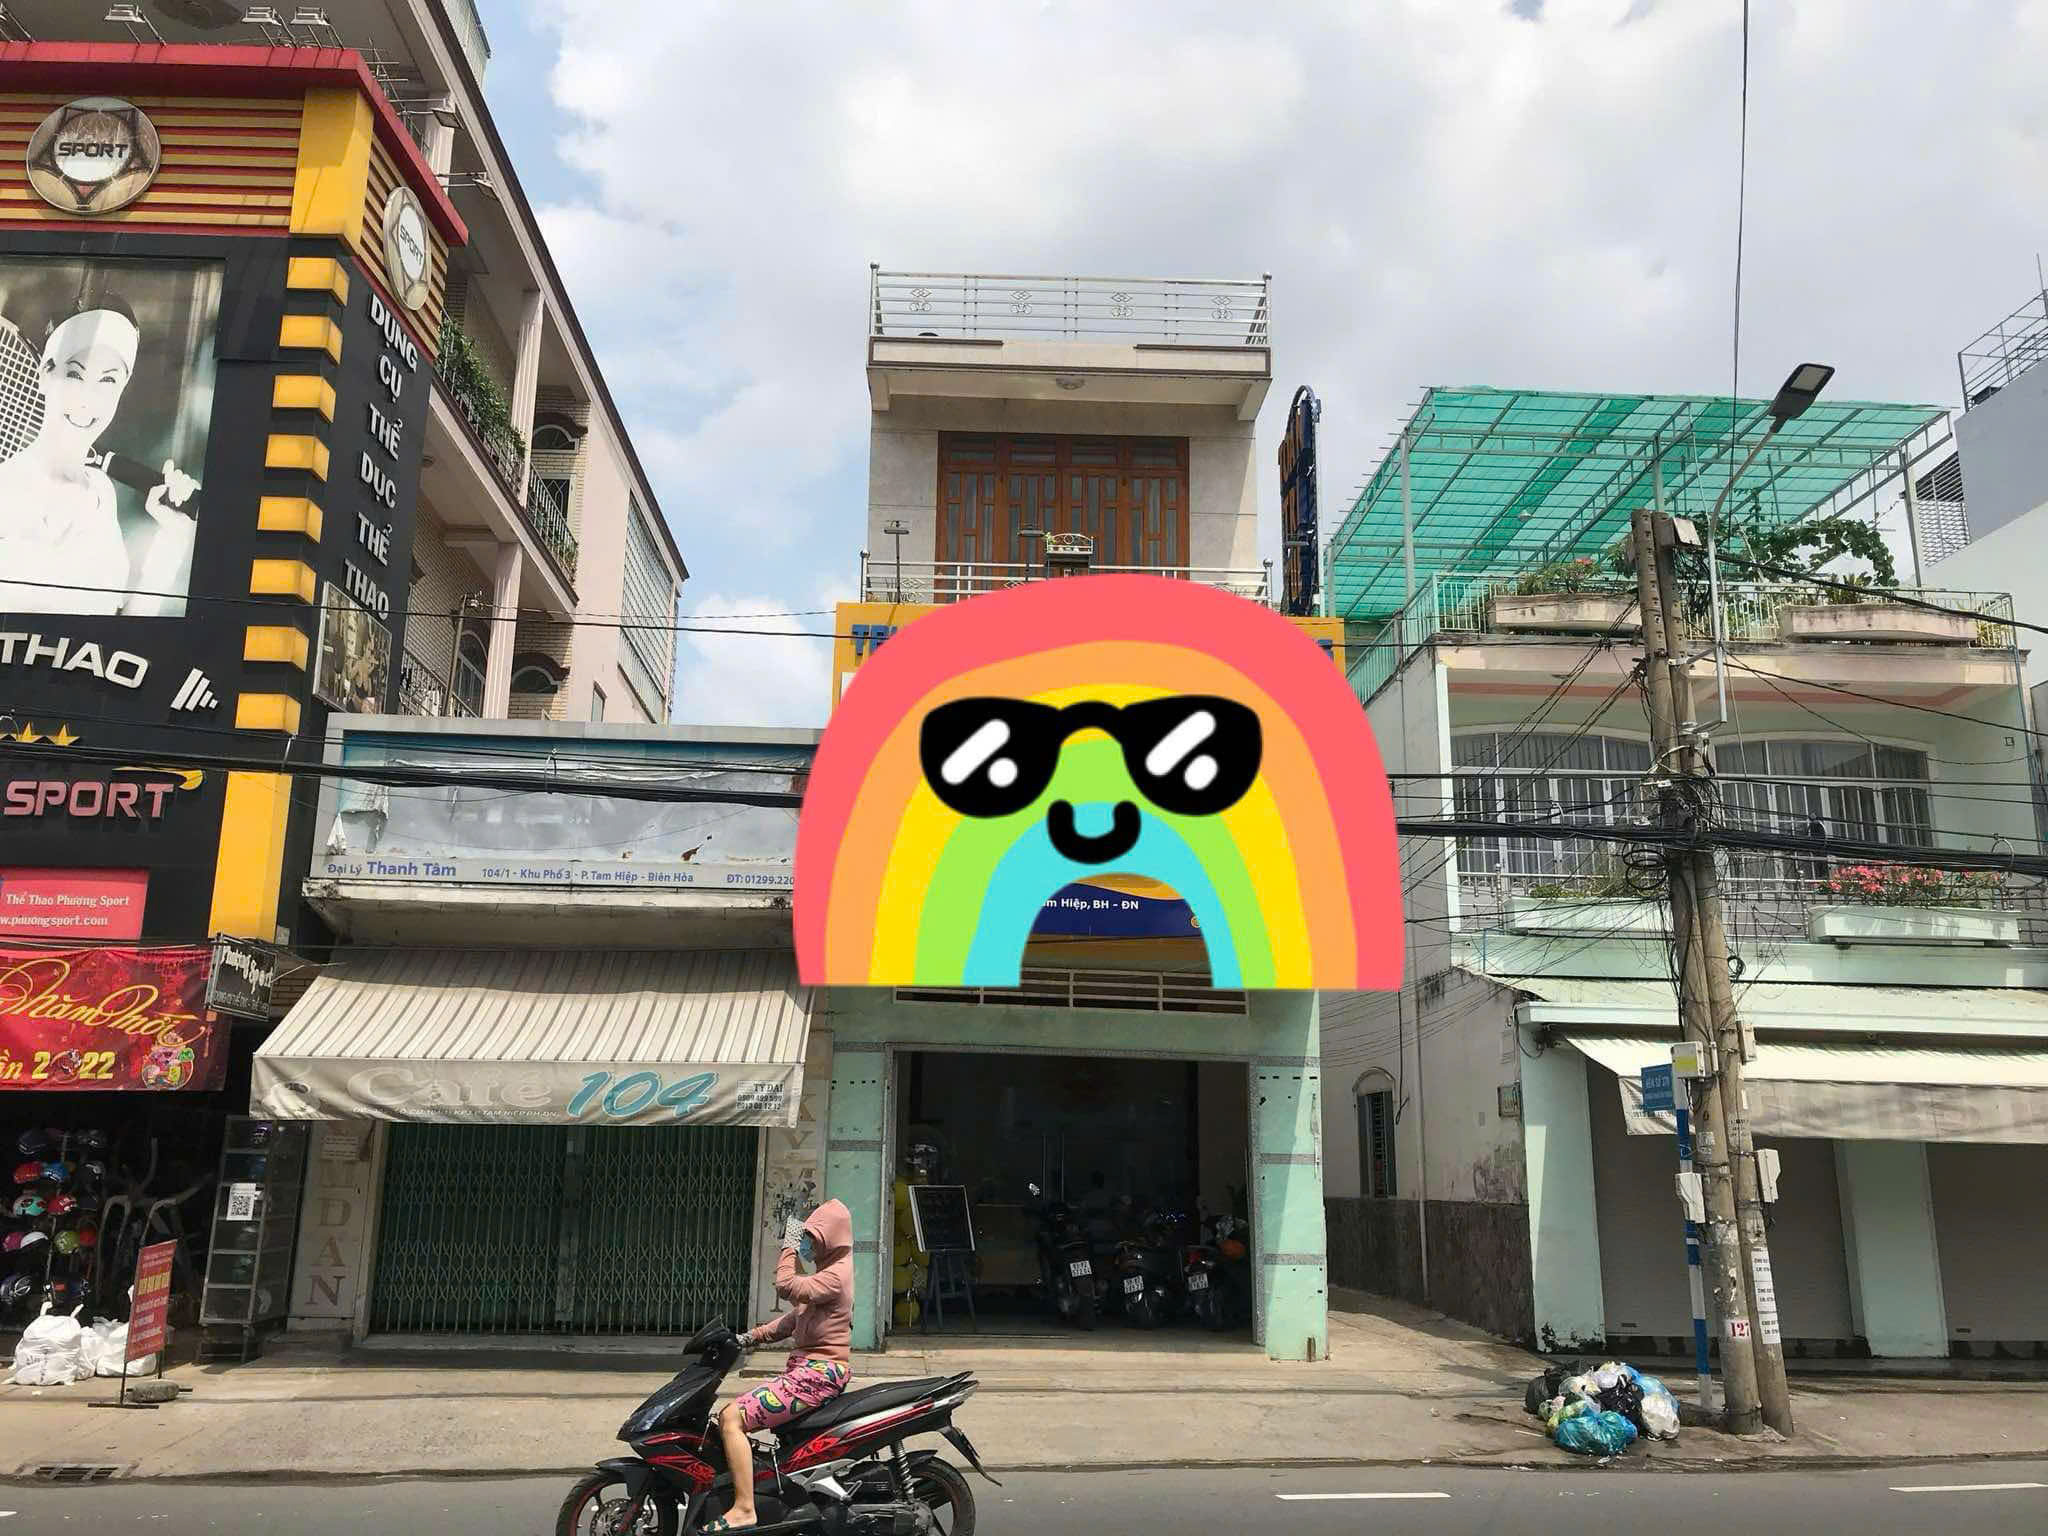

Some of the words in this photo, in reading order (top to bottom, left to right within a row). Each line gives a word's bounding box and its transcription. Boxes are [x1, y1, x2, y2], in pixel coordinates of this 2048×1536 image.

[58, 142, 128, 158] SPORT
[400, 223, 424, 266] SPORT
[371, 293, 418, 373] DỤNG
[379, 355, 403, 403] CỤ
[369, 402, 403, 461] THỂ
[361, 451, 397, 509] DỤC
[357, 511, 393, 567] THỂ
[345, 558, 389, 620] THAO
[0, 632, 149, 689] THAO
[4, 780, 174, 818] SPORT
[328, 864, 347, 876] Đại
[350, 865, 362, 876] Lý
[367, 861, 418, 876] Thanh
[423, 862, 456, 877] Tâm
[482, 868, 510, 879] 104/1
[520, 868, 541, 879] Khu
[614, 871, 638, 884] Hiệp
[29, 894, 54, 906] Thao
[100, 895, 129, 908] Sport
[1121, 900, 1139, 910] ĐN
[567, 1070, 720, 1118] 104
